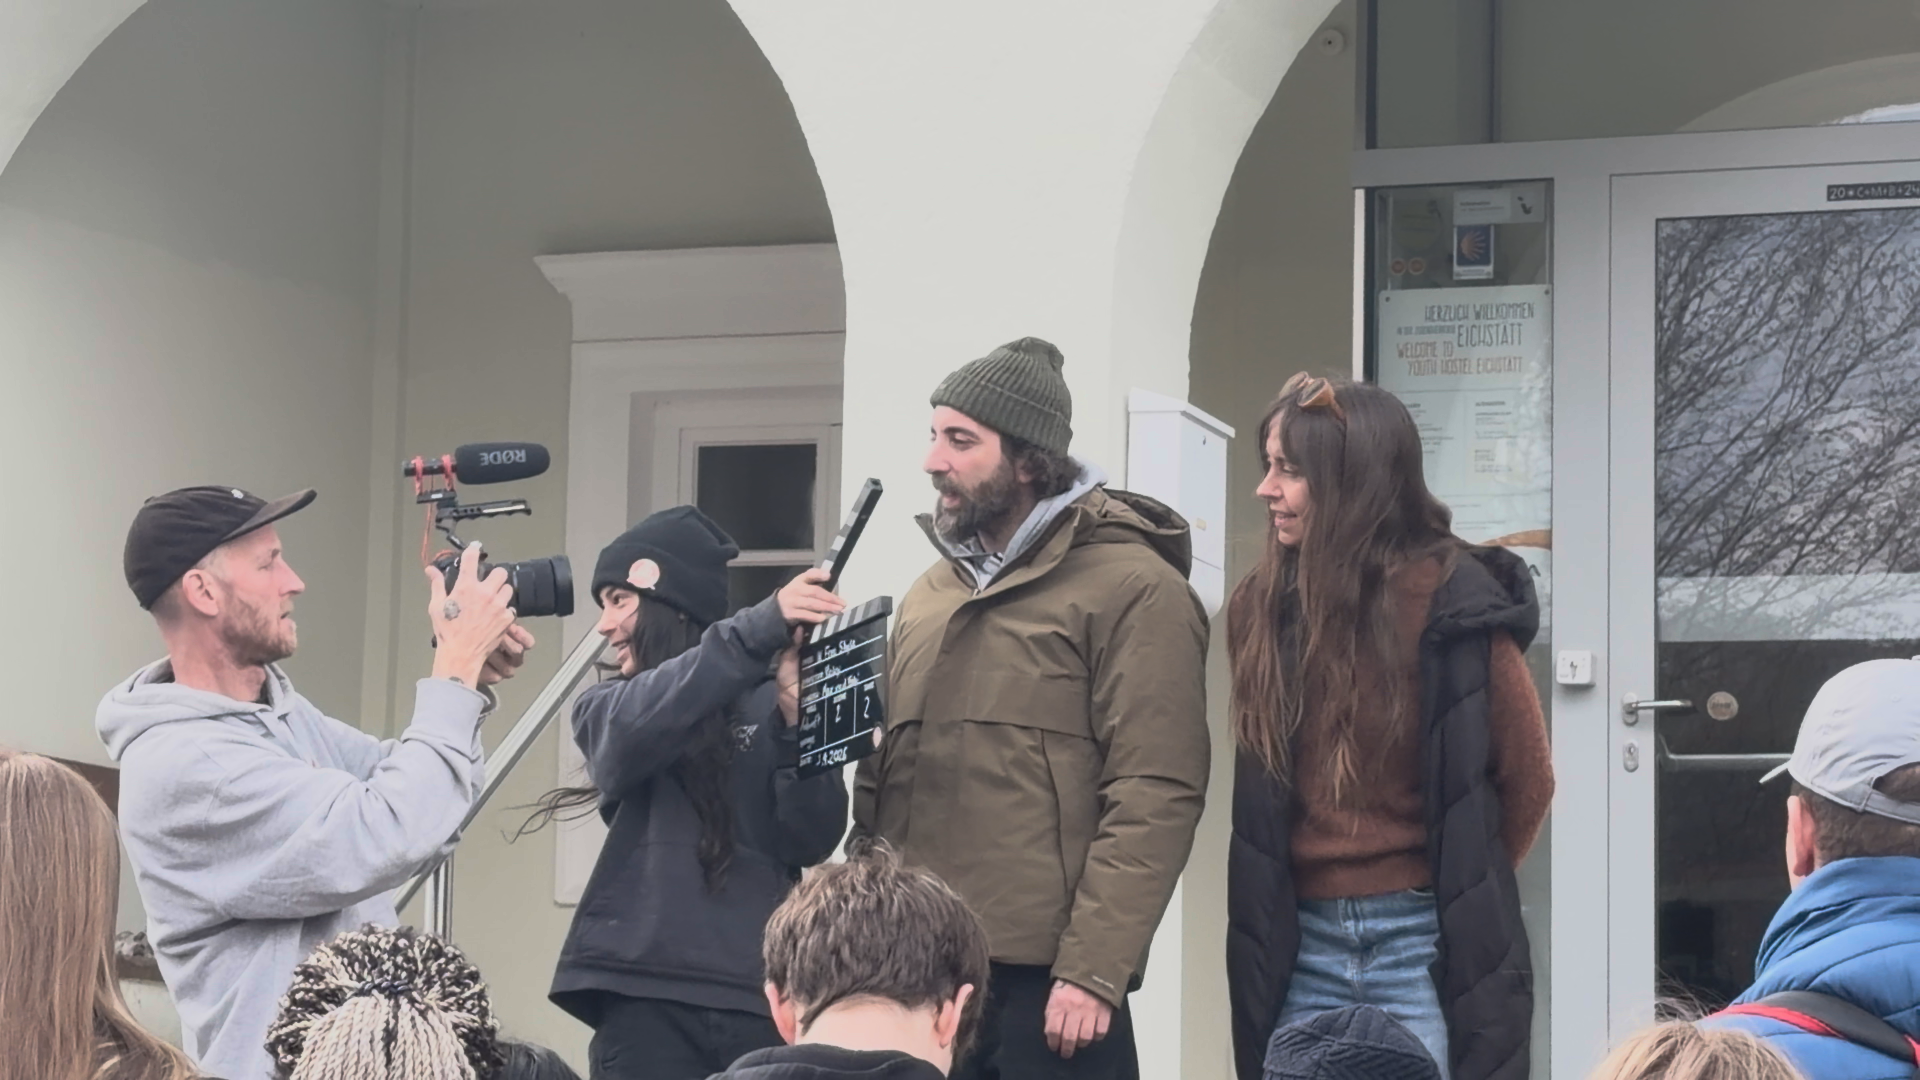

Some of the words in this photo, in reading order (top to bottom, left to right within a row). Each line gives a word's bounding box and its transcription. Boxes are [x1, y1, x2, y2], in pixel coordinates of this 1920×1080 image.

[1424, 304, 1469, 322] HERZLICH
[1473, 302, 1535, 320] WILLKOMMEN
[1396, 341, 1438, 359] WELCOME
[1443, 340, 1454, 358] TO
[1407, 359, 1437, 376] YOUTH
[1440, 358, 1474, 375] HOSTEL
